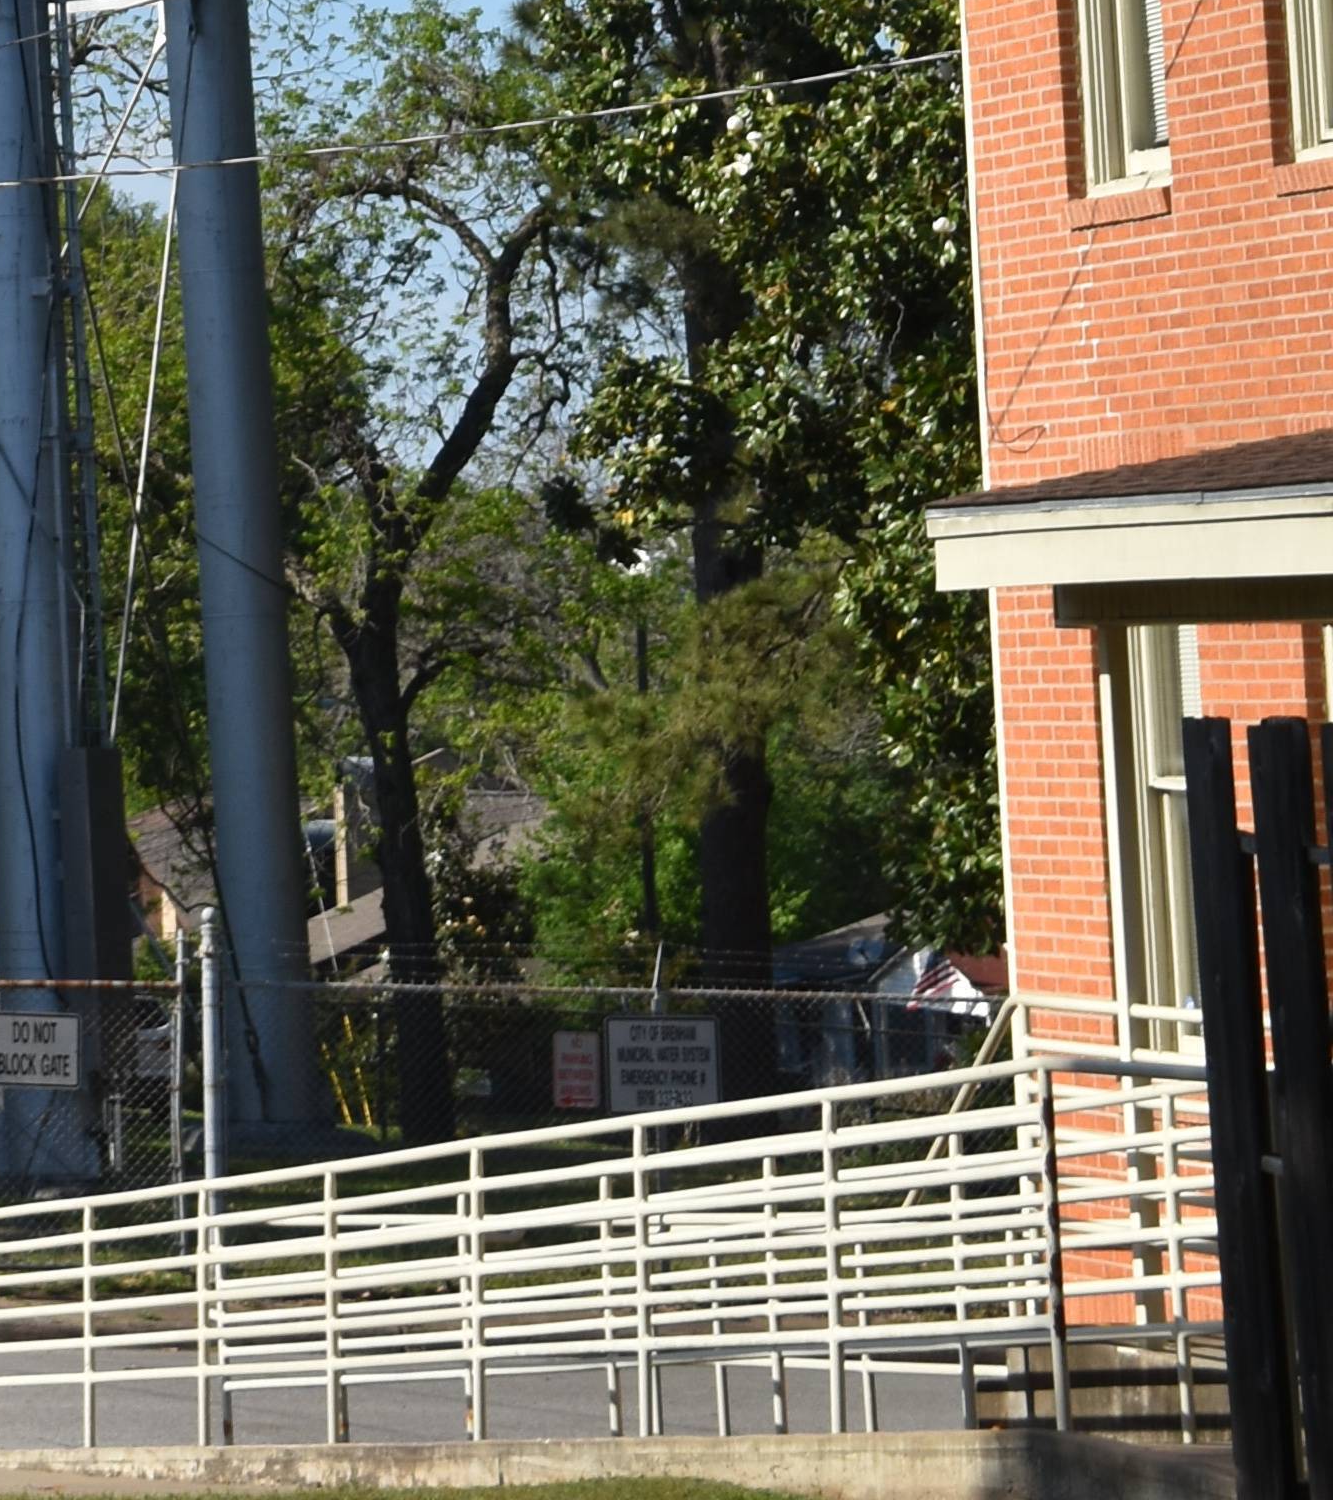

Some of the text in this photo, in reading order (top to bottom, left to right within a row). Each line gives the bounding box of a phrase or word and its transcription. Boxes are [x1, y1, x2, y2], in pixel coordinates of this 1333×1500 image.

[13, 1021, 57, 1043] DO NOT
[630, 1025, 647, 1041] CITY
[41, 1054, 70, 1076] GATE
[620, 1069, 668, 1086] EMERGENCY
[671, 1069, 698, 1086] PHONE
